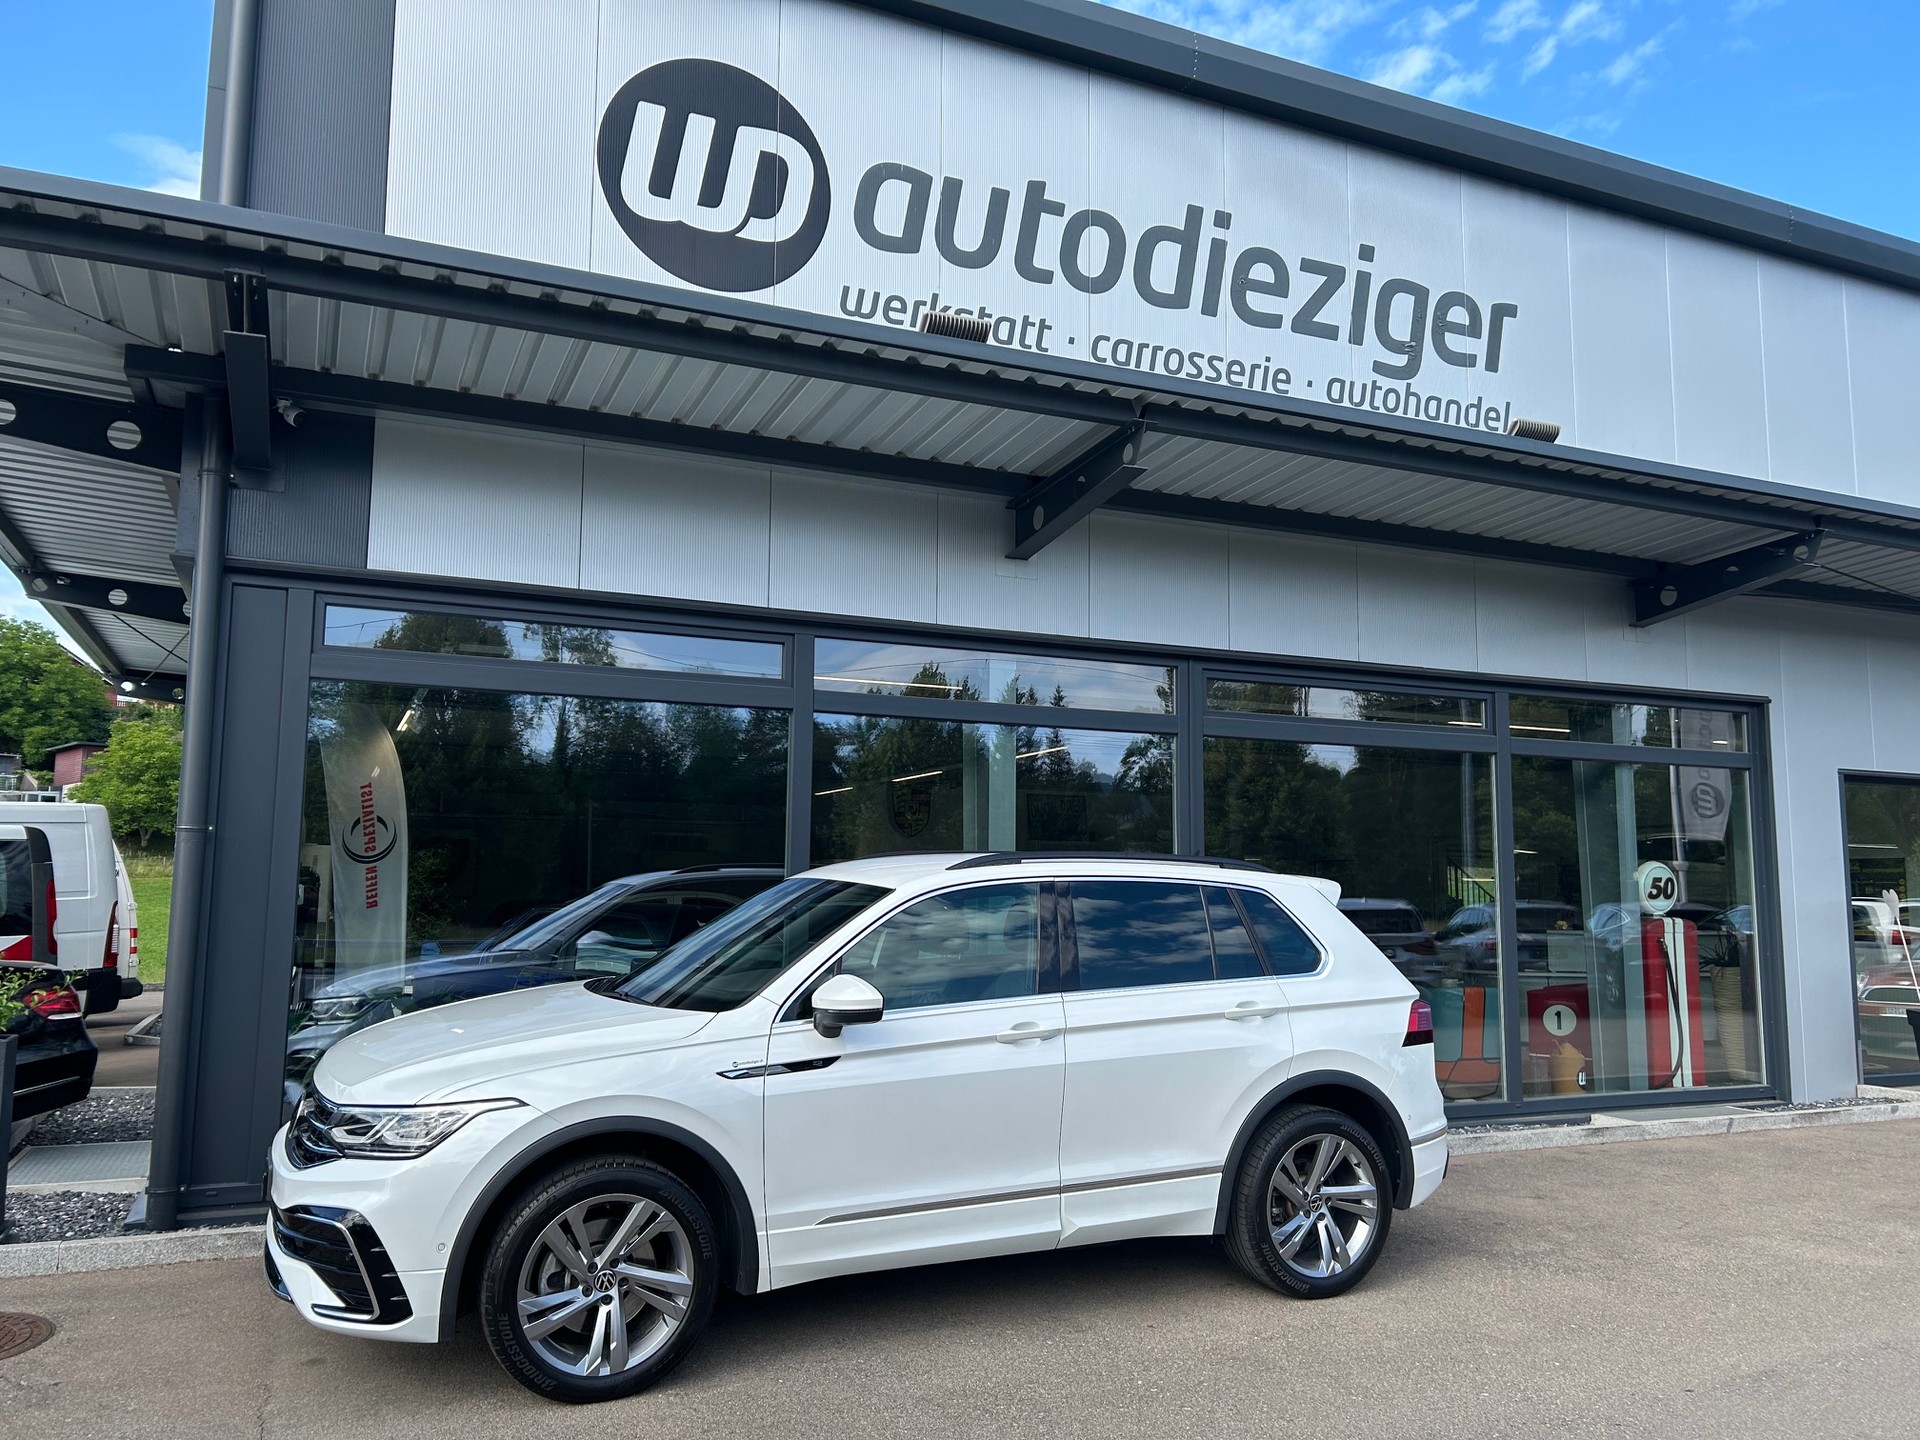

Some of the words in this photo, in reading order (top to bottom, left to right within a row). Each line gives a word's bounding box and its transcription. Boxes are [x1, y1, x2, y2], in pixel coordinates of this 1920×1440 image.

[854, 161, 1518, 380] autodieziger
[1090, 334, 1291, 395] carrosserie
[1326, 377, 1511, 433] autohandel
[1647, 877, 1675, 900] 50
[1554, 1010, 1562, 1030] 1
[1260, 1241, 1311, 1293] BRIDGESTONE
[497, 1312, 558, 1391] BRIDGESTONE
